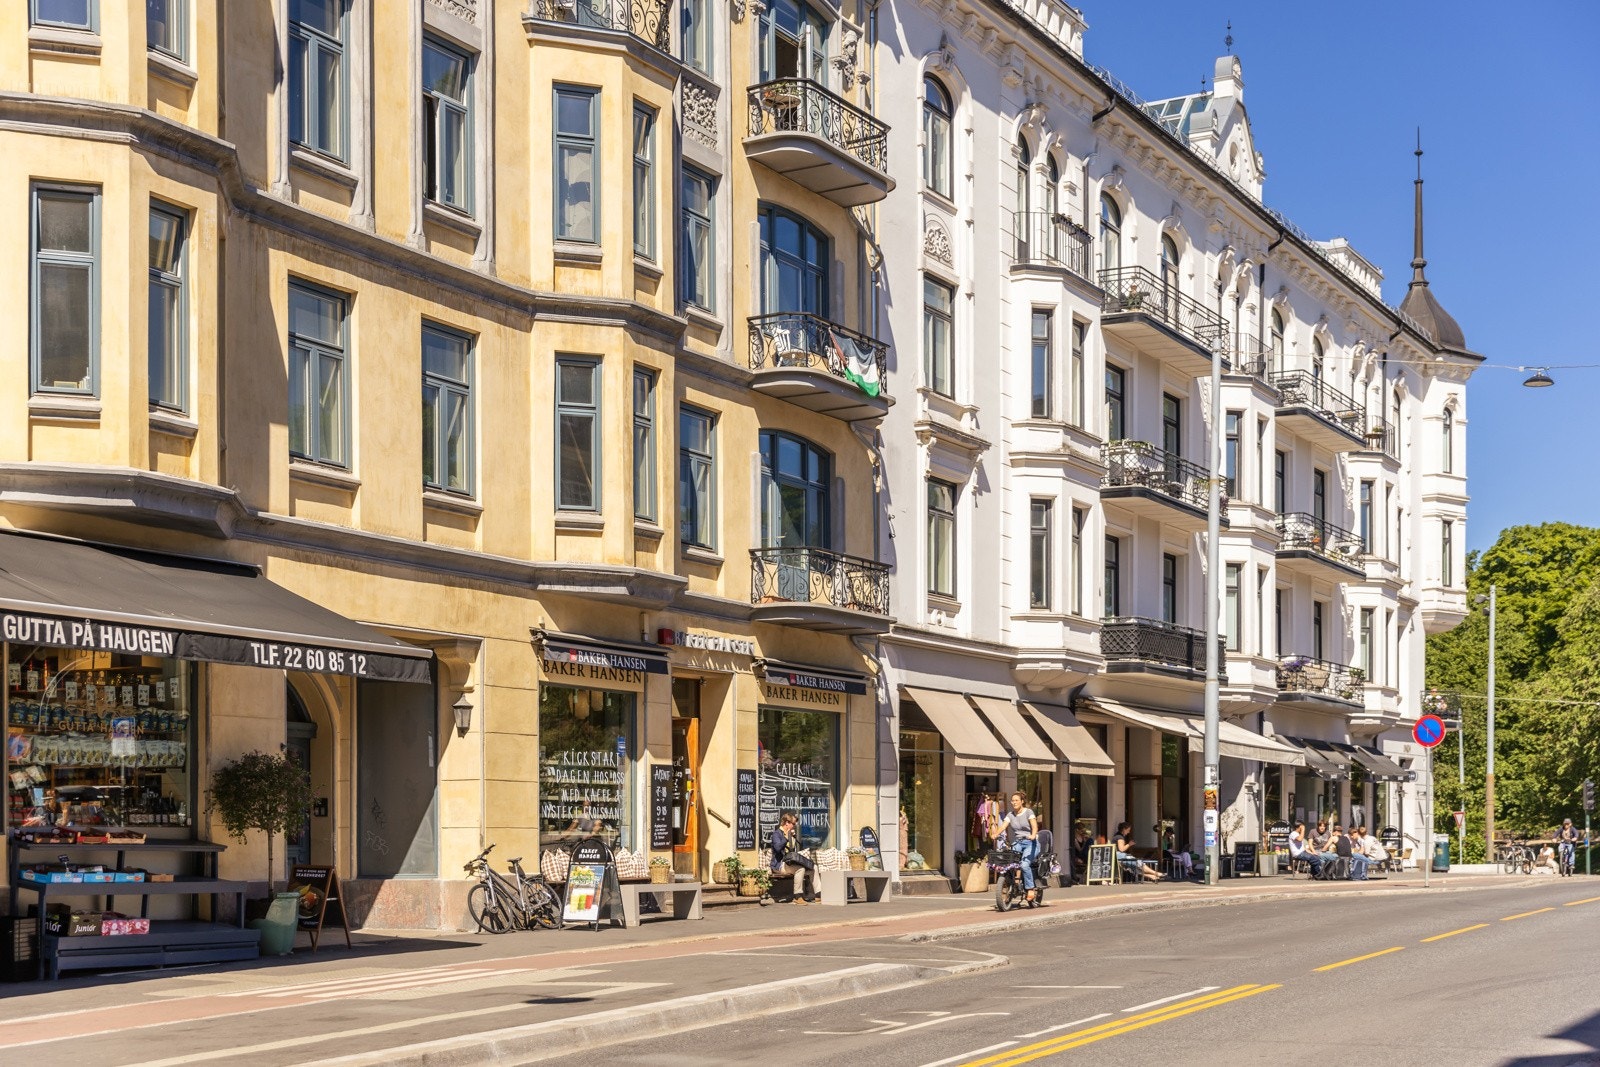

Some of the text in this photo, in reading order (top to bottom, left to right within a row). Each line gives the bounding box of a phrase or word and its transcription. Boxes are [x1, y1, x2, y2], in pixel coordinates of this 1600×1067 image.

[3, 615, 174, 655] GUTTA PÅ HAUGEN
[250, 642, 367, 675] TLF. 22 60 85 12
[578, 650, 647, 670] BAKER HANSEN
[543, 659, 642, 683] BAKER HANSEN
[796, 675, 846, 691] BAKER HANSEN
[766, 685, 840, 705] BAKER HANSEN
[59, 720, 94, 732] GUTTA
[556, 769, 625, 785] DAGEN HOS OSS
[561, 788, 580, 802] MED
[584, 788, 611, 803] KAFFE
[781, 796, 804, 809] STORE
[808, 797, 815, 809] OG
[541, 804, 579, 819] NYSTEKT
[45, 921, 61, 932] nior
